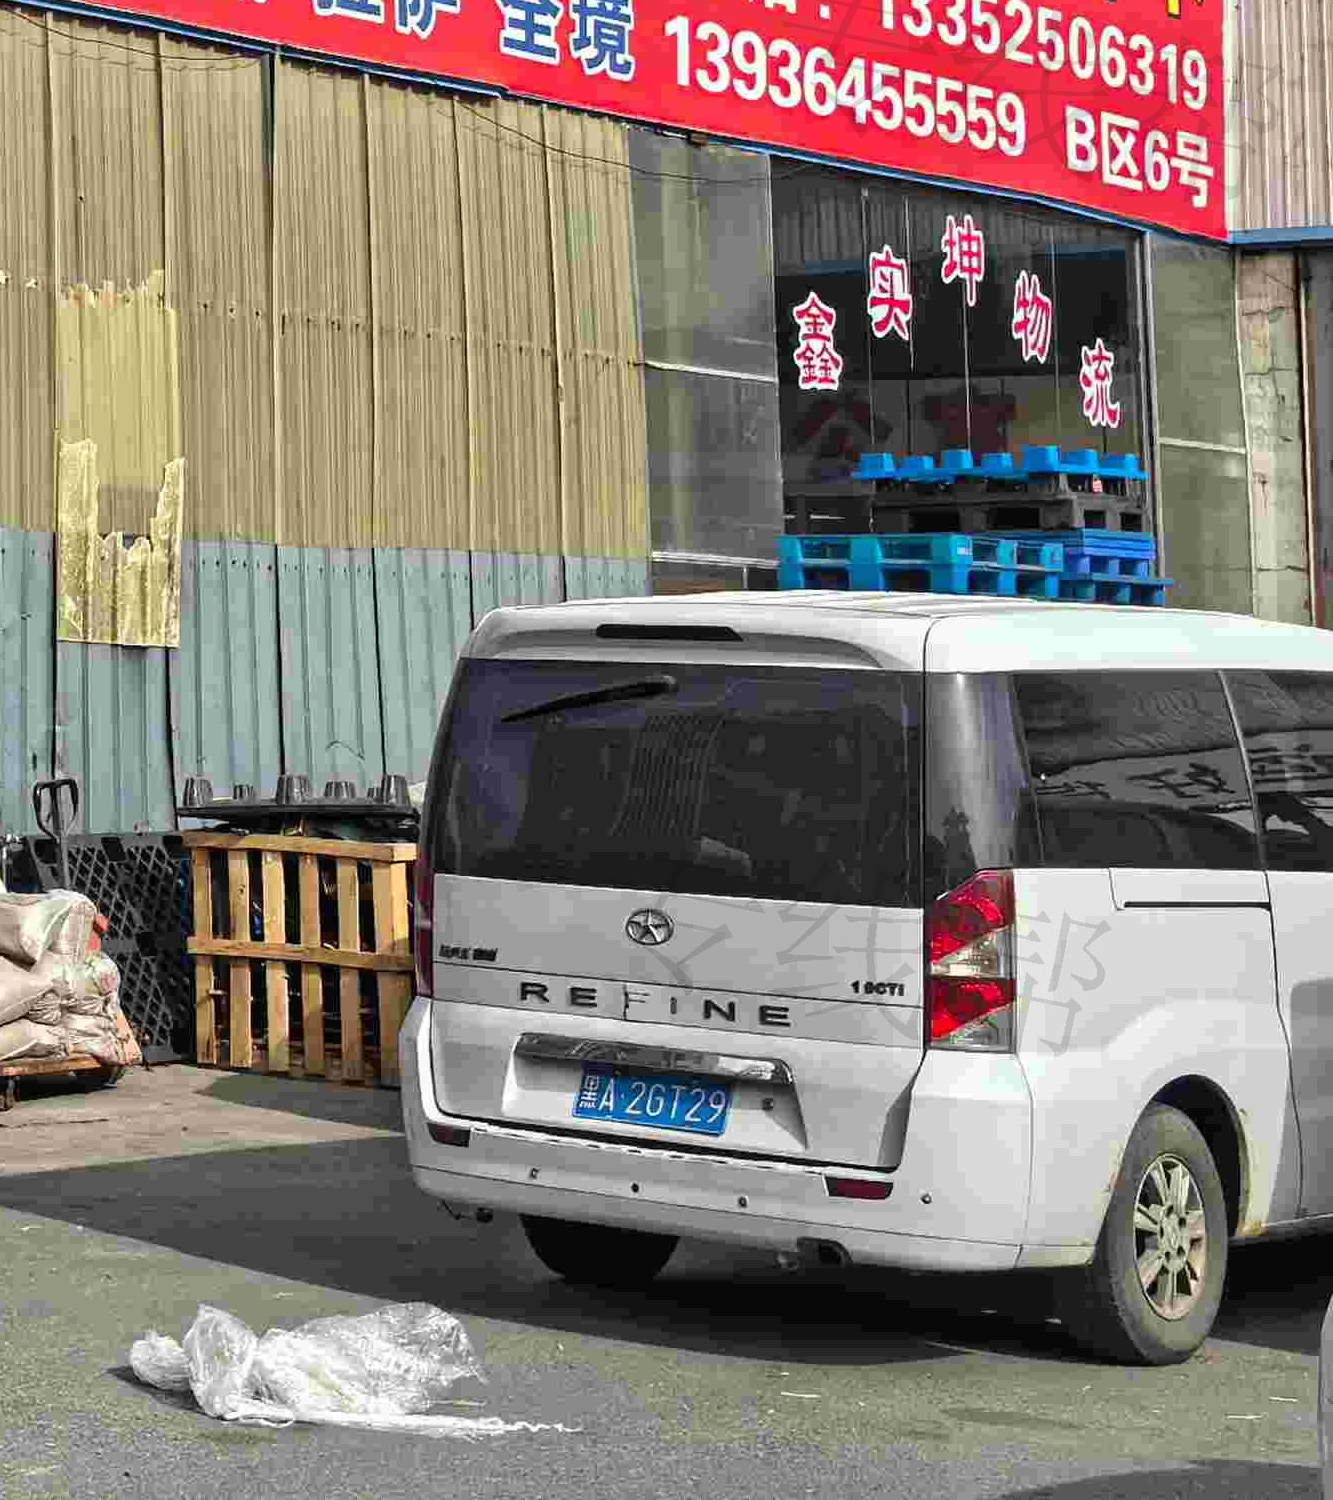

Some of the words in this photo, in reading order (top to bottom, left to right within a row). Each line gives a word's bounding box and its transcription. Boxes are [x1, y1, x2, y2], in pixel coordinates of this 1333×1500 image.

[664, 15, 1026, 157] 13936455559
[1065, 105, 1214, 210] B区6号
[792, 213, 1120, 429] 鑫实坤物流
[518, 980, 793, 1028] REFINE
